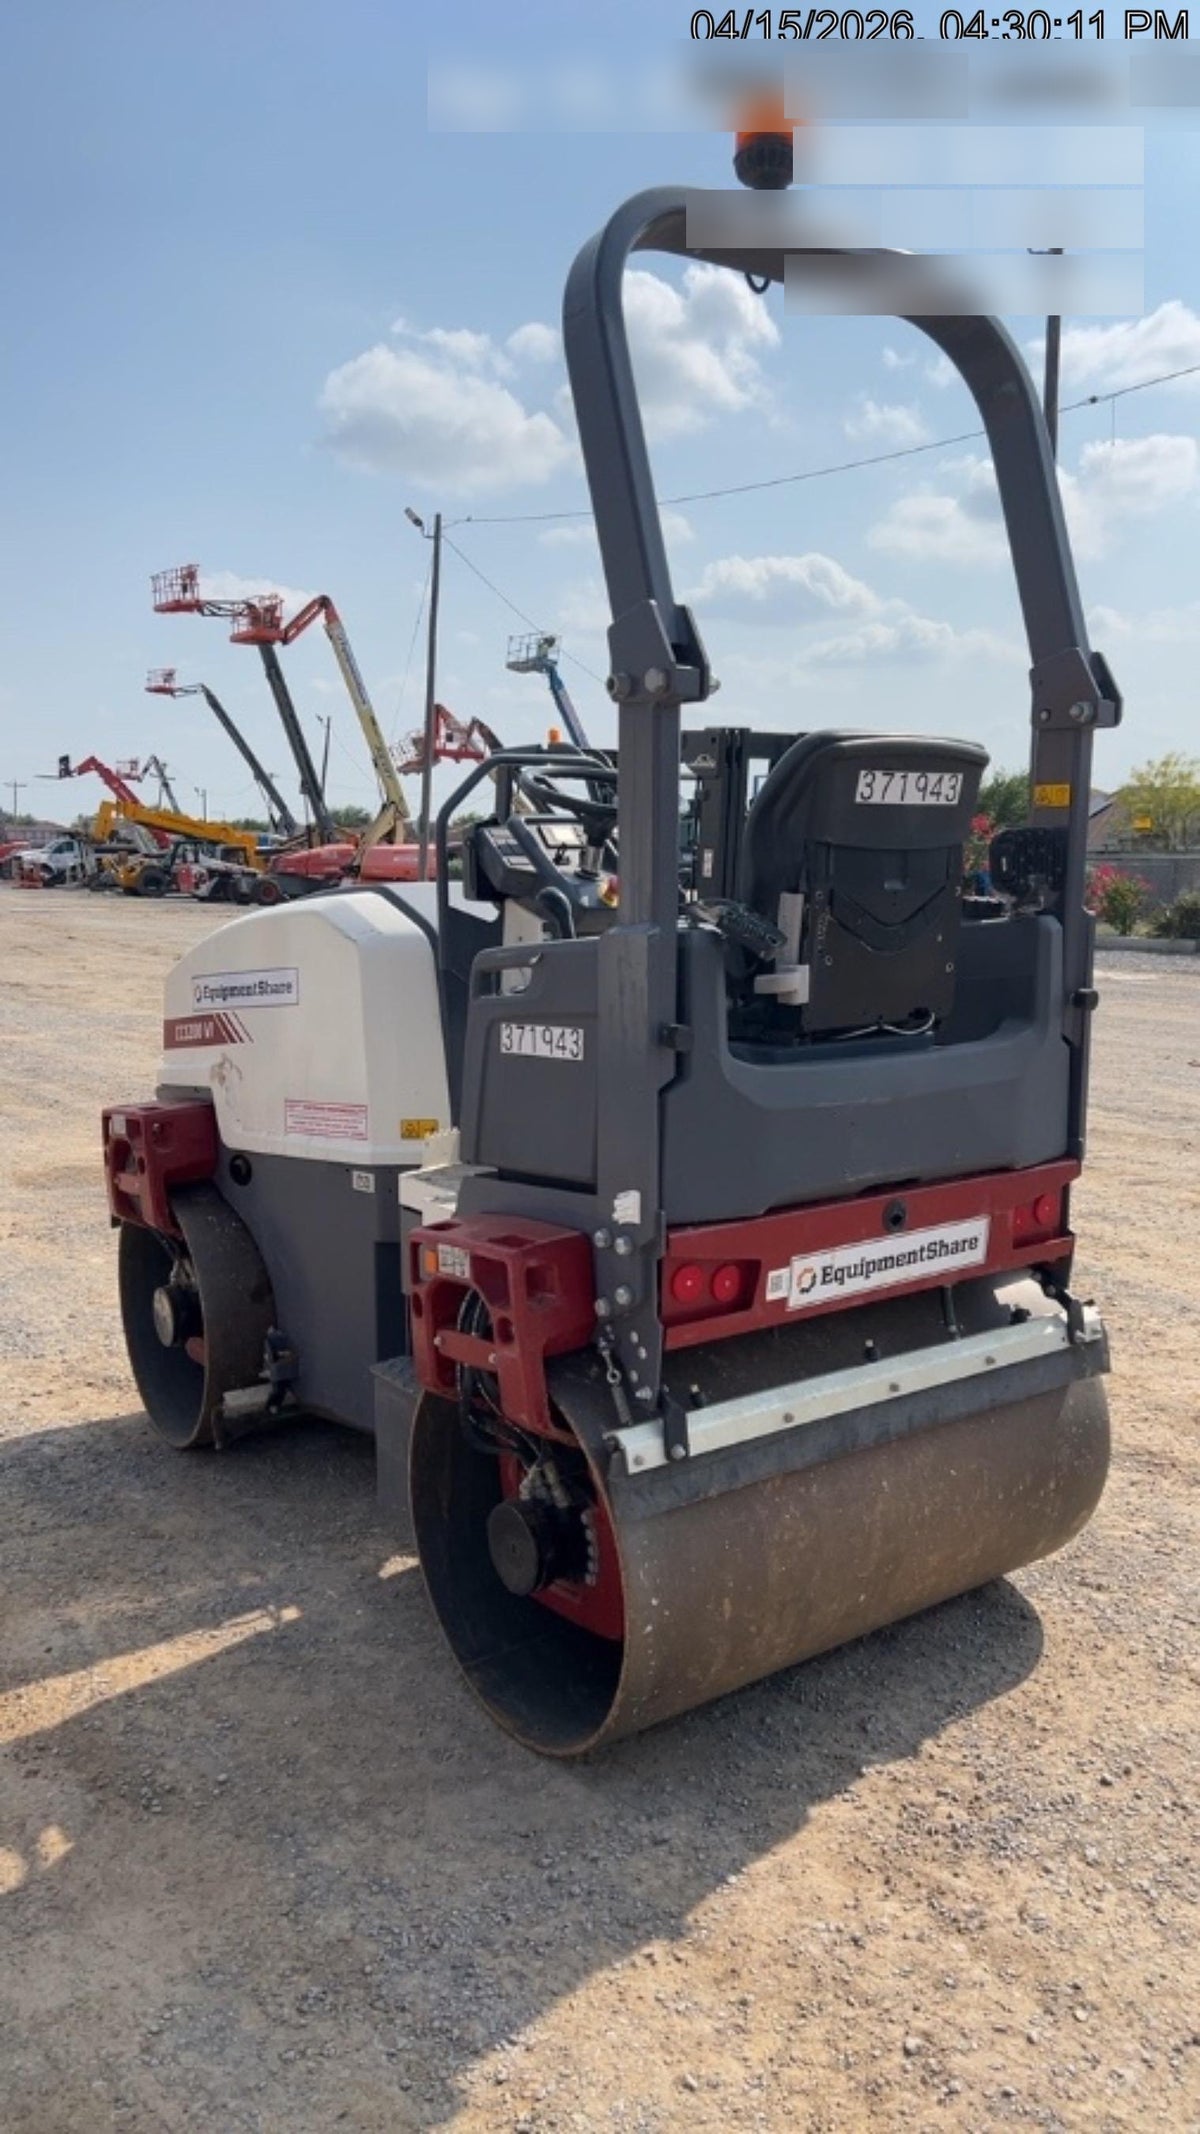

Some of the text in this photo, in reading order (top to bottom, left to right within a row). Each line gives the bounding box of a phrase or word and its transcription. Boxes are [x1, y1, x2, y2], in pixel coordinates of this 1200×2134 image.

[860, 770, 959, 802] 371943
[203, 980, 293, 1002] EquipmentShare
[501, 1023, 580, 1058] 371943
[820, 1236, 980, 1286] EquipmentShare
